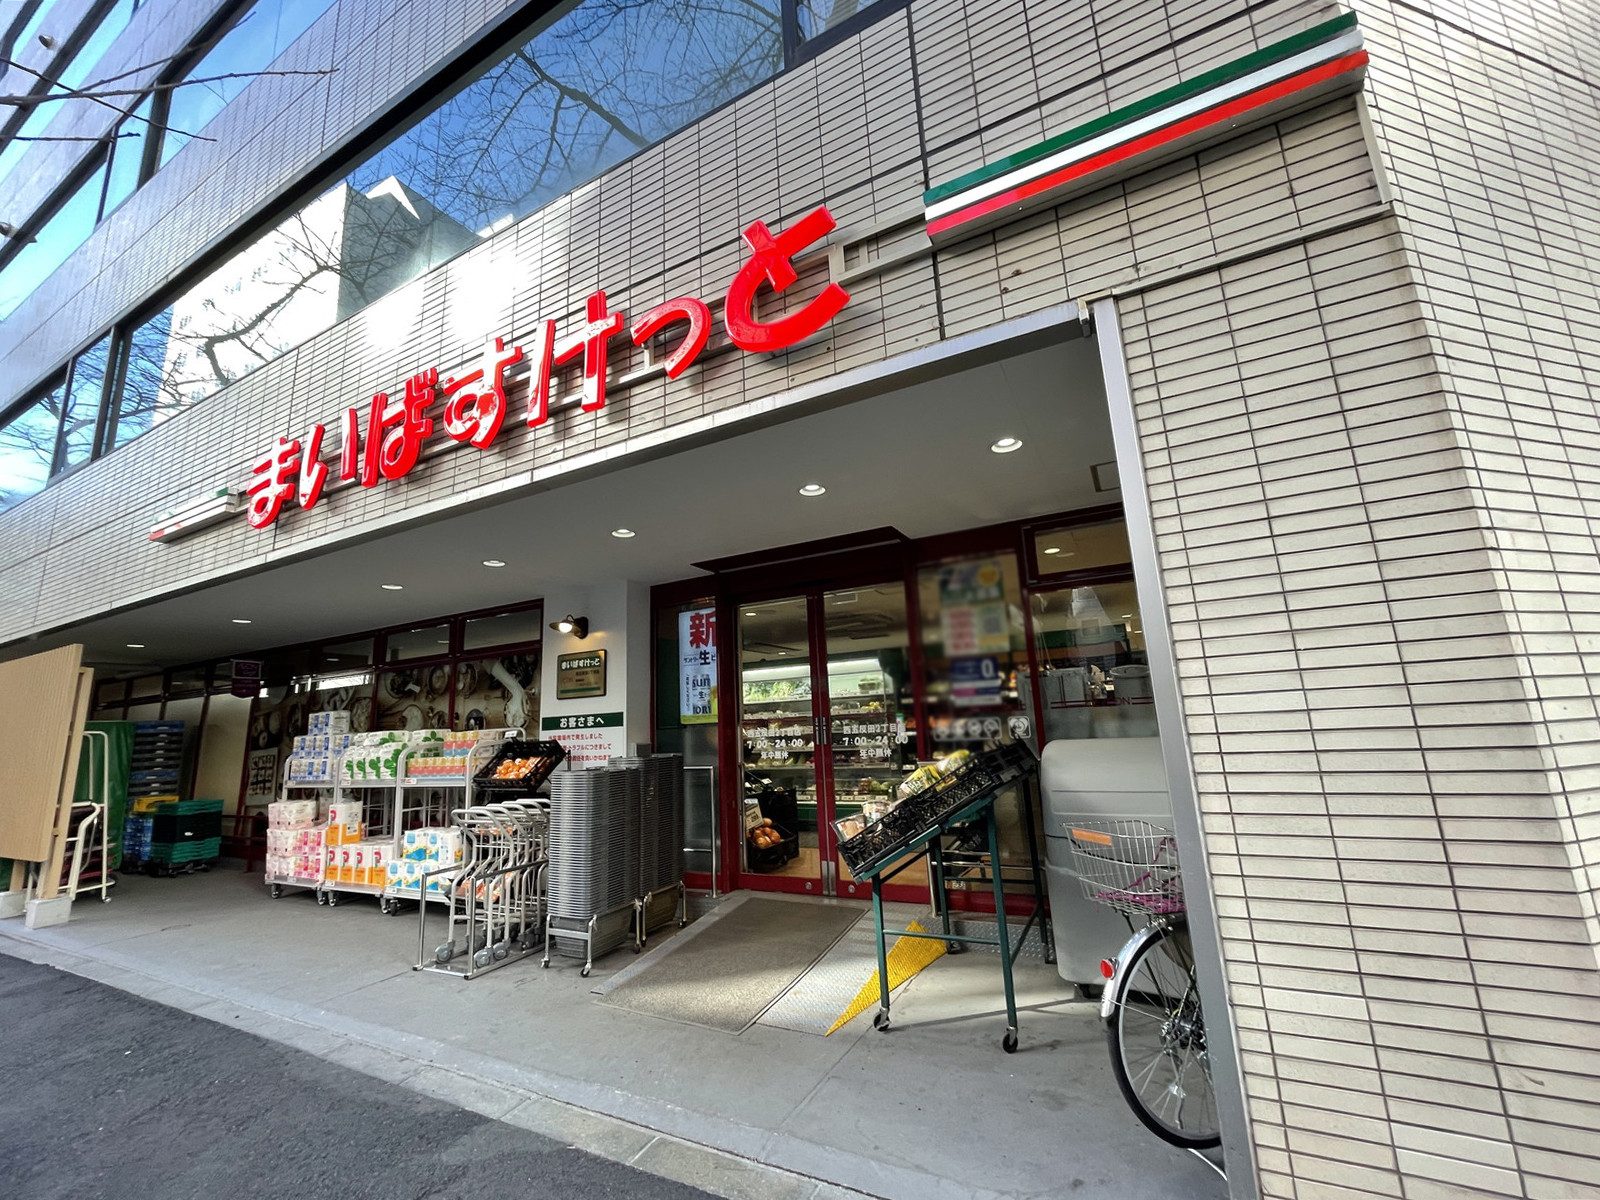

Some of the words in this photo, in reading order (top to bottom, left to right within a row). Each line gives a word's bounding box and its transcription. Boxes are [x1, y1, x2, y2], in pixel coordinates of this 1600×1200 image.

[247, 206, 850, 529] まいばすけっと
[689, 612, 716, 648] 新
[561, 657, 600, 670] まいばすけっと
[560, 716, 604, 728] お客さまへ
[761, 751, 789, 759] 年中無休
[860, 748, 892, 759] 年中無休
